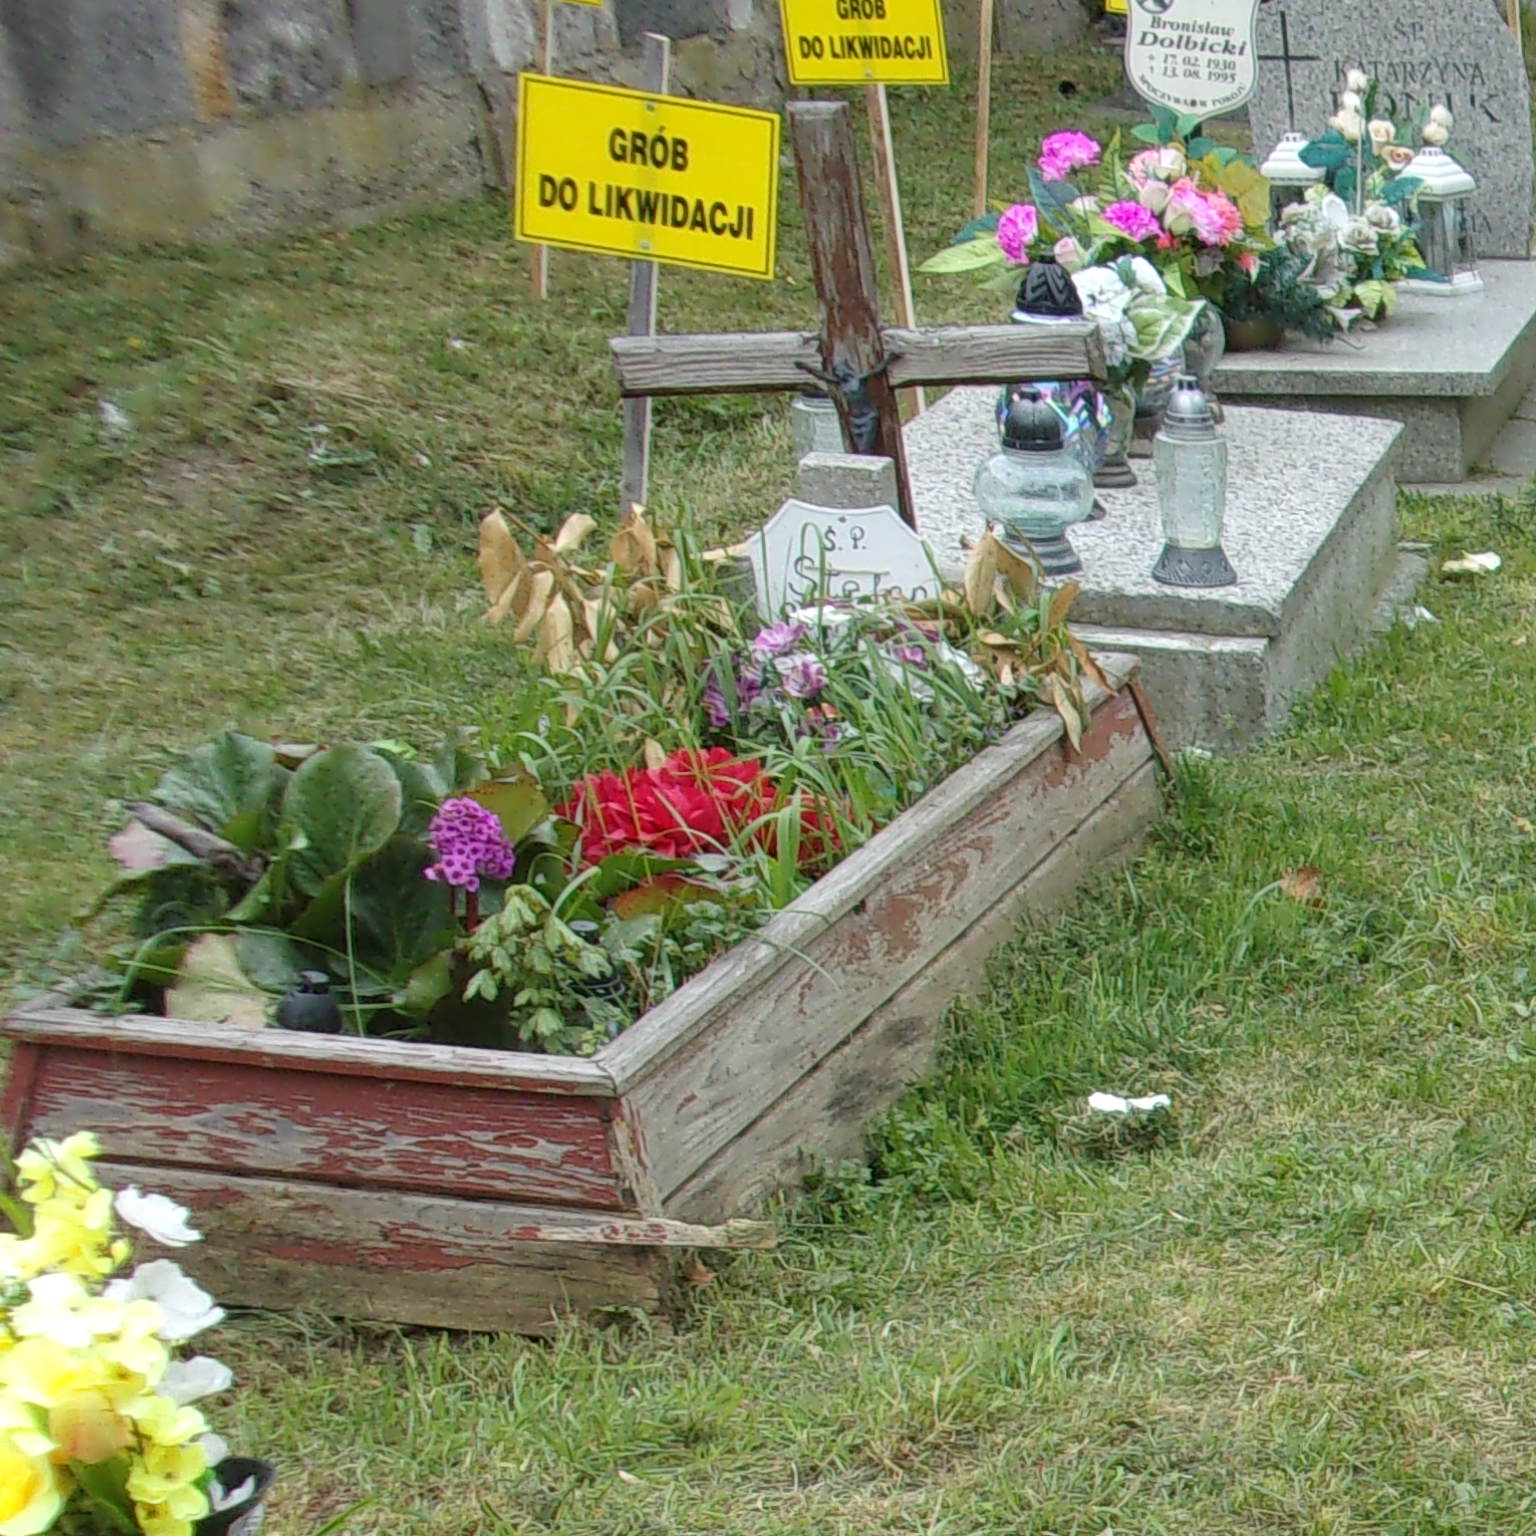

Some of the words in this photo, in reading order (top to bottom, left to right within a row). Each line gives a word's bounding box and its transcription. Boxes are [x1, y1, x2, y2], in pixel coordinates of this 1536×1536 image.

[799, 36, 824, 59] DO
[829, 35, 932, 59] LIKWIDACJI
[1137, 30, 1247, 56] Dolbicki
[1206, 58, 1237, 71] 1930
[1207, 71, 1237, 84] 1995
[609, 126, 689, 172] GRÓB
[539, 173, 579, 212] DO
[588, 181, 754, 240] LIKWIDACJI
